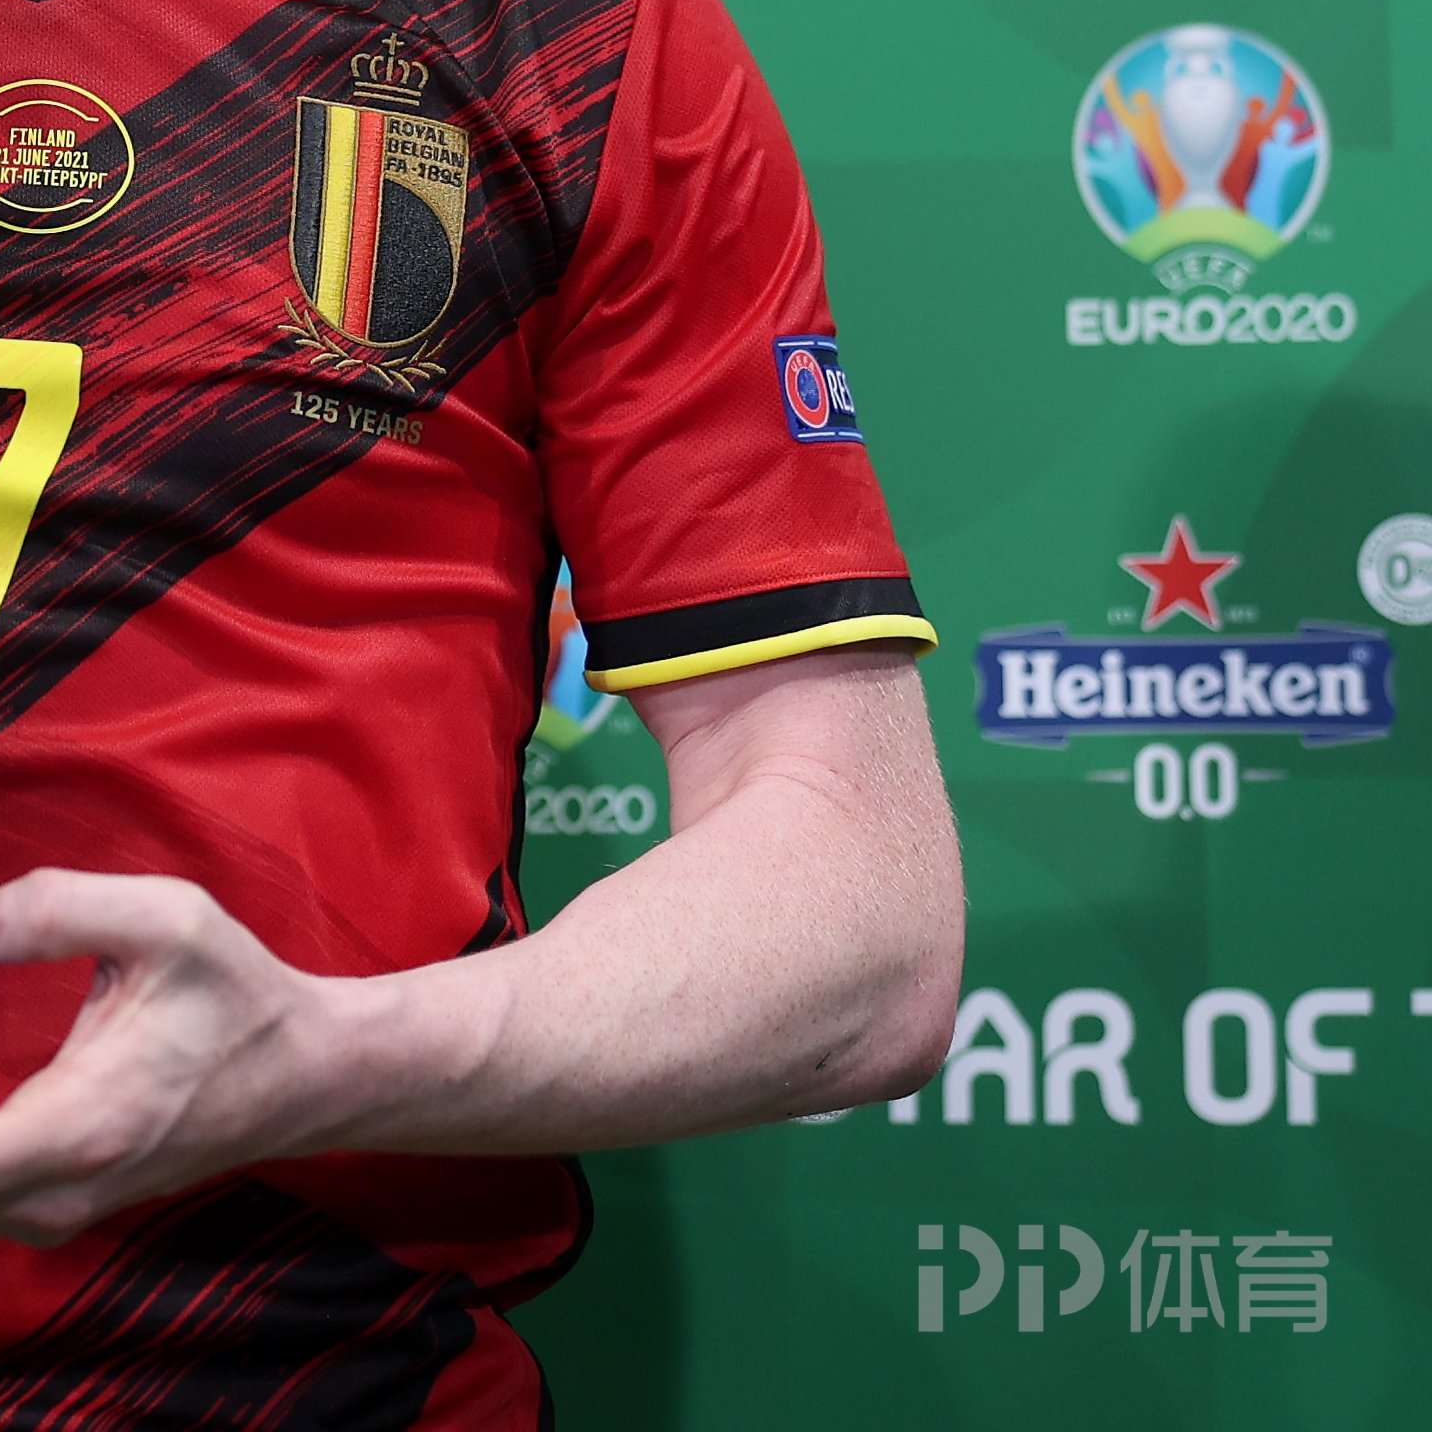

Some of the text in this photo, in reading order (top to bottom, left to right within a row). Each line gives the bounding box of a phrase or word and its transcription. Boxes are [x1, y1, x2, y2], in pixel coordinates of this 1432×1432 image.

[9, 127, 76, 148] FINLAND
[12, 148, 52, 167] JUNE
[54, 150, 89, 169] 2021
[387, 137, 465, 168] BELGIAN
[389, 118, 448, 146] ROYAL
[1065, 293, 1358, 346] EURO2020
[290, 391, 424, 445] 125 YEARS
[998, 649, 1370, 720] Heineken
[1134, 742, 1238, 820] 0.0
[1182, 988, 1374, 1125] OF
